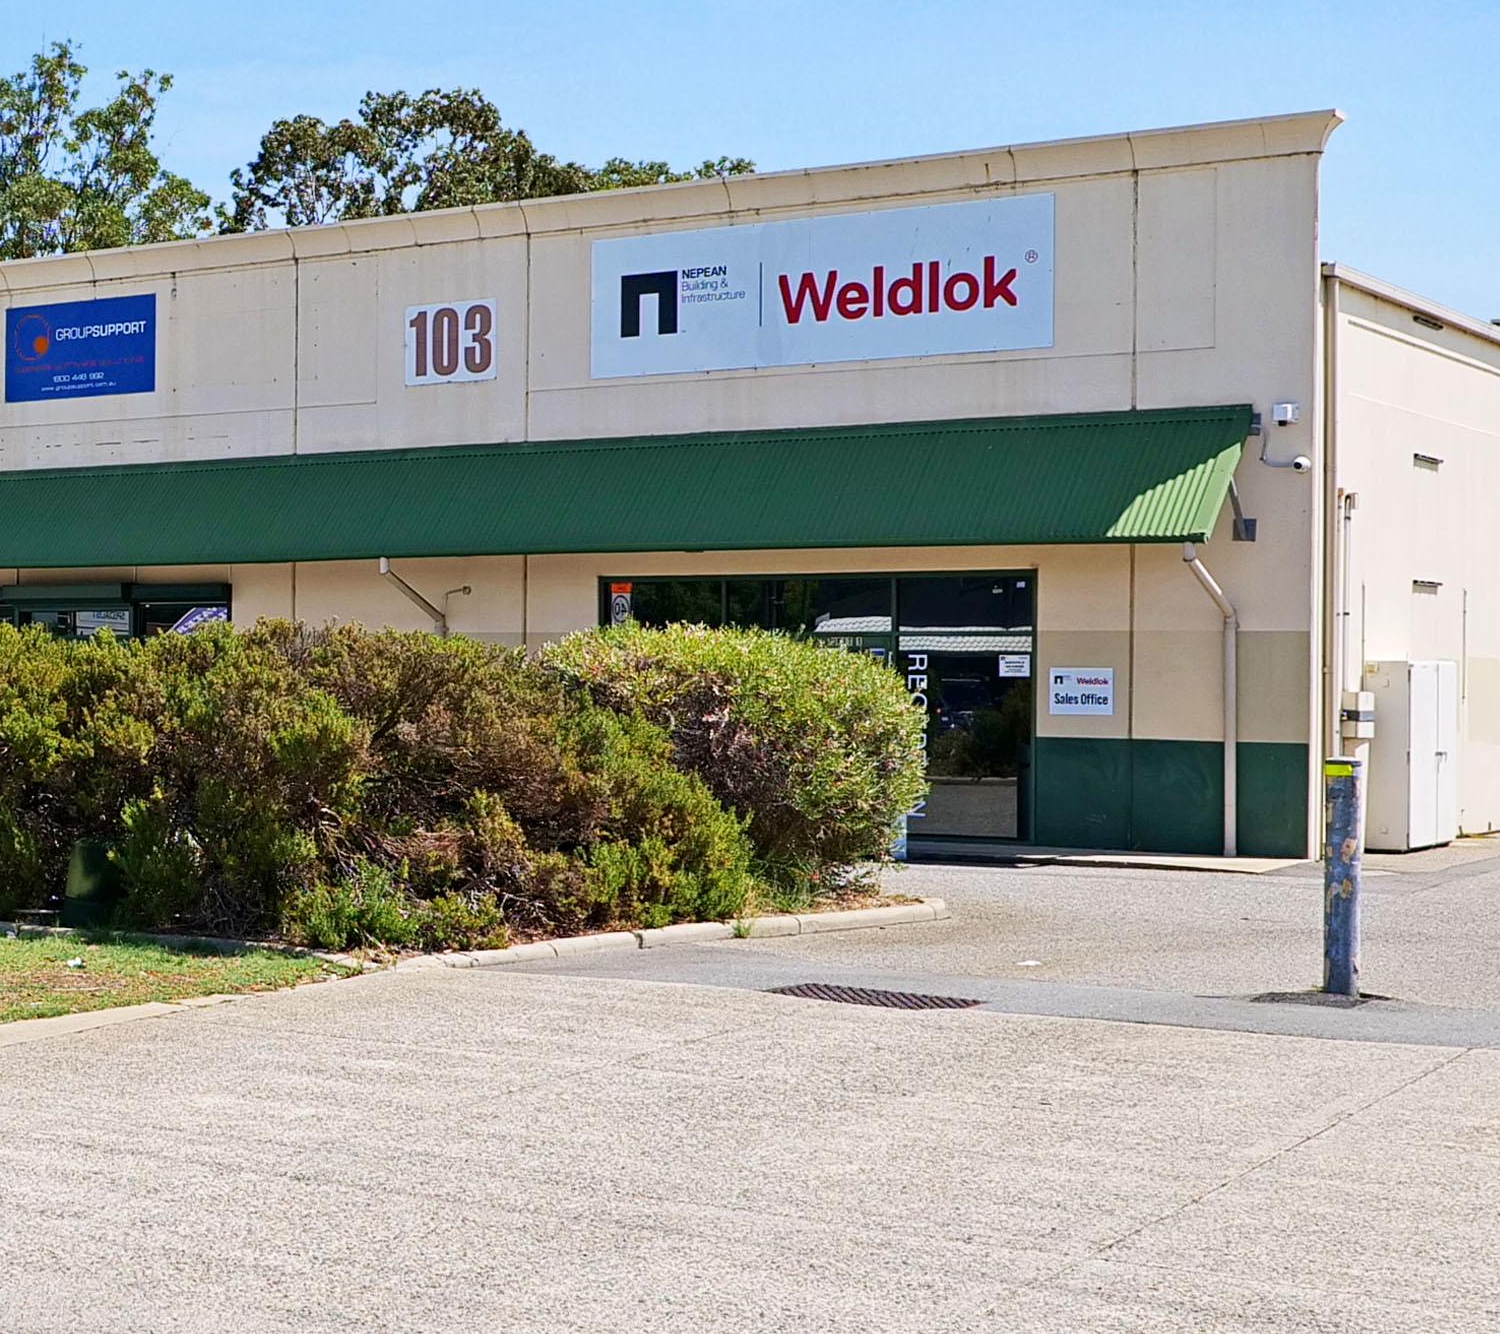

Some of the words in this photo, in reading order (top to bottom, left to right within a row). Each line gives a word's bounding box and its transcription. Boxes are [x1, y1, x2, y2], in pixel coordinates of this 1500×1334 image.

[682, 266, 727, 279] NEPEAN
[682, 279, 718, 292] Building
[720, 278, 728, 288] &
[778, 256, 1018, 324] Weldlok
[682, 290, 746, 304] Infrastructure
[55, 321, 146, 341] GROUPSUPPORT
[409, 304, 492, 376] 103
[1076, 677, 1108, 685] Weldlok
[1054, 693, 1079, 705] Sales
[1080, 693, 1109, 705] Office
